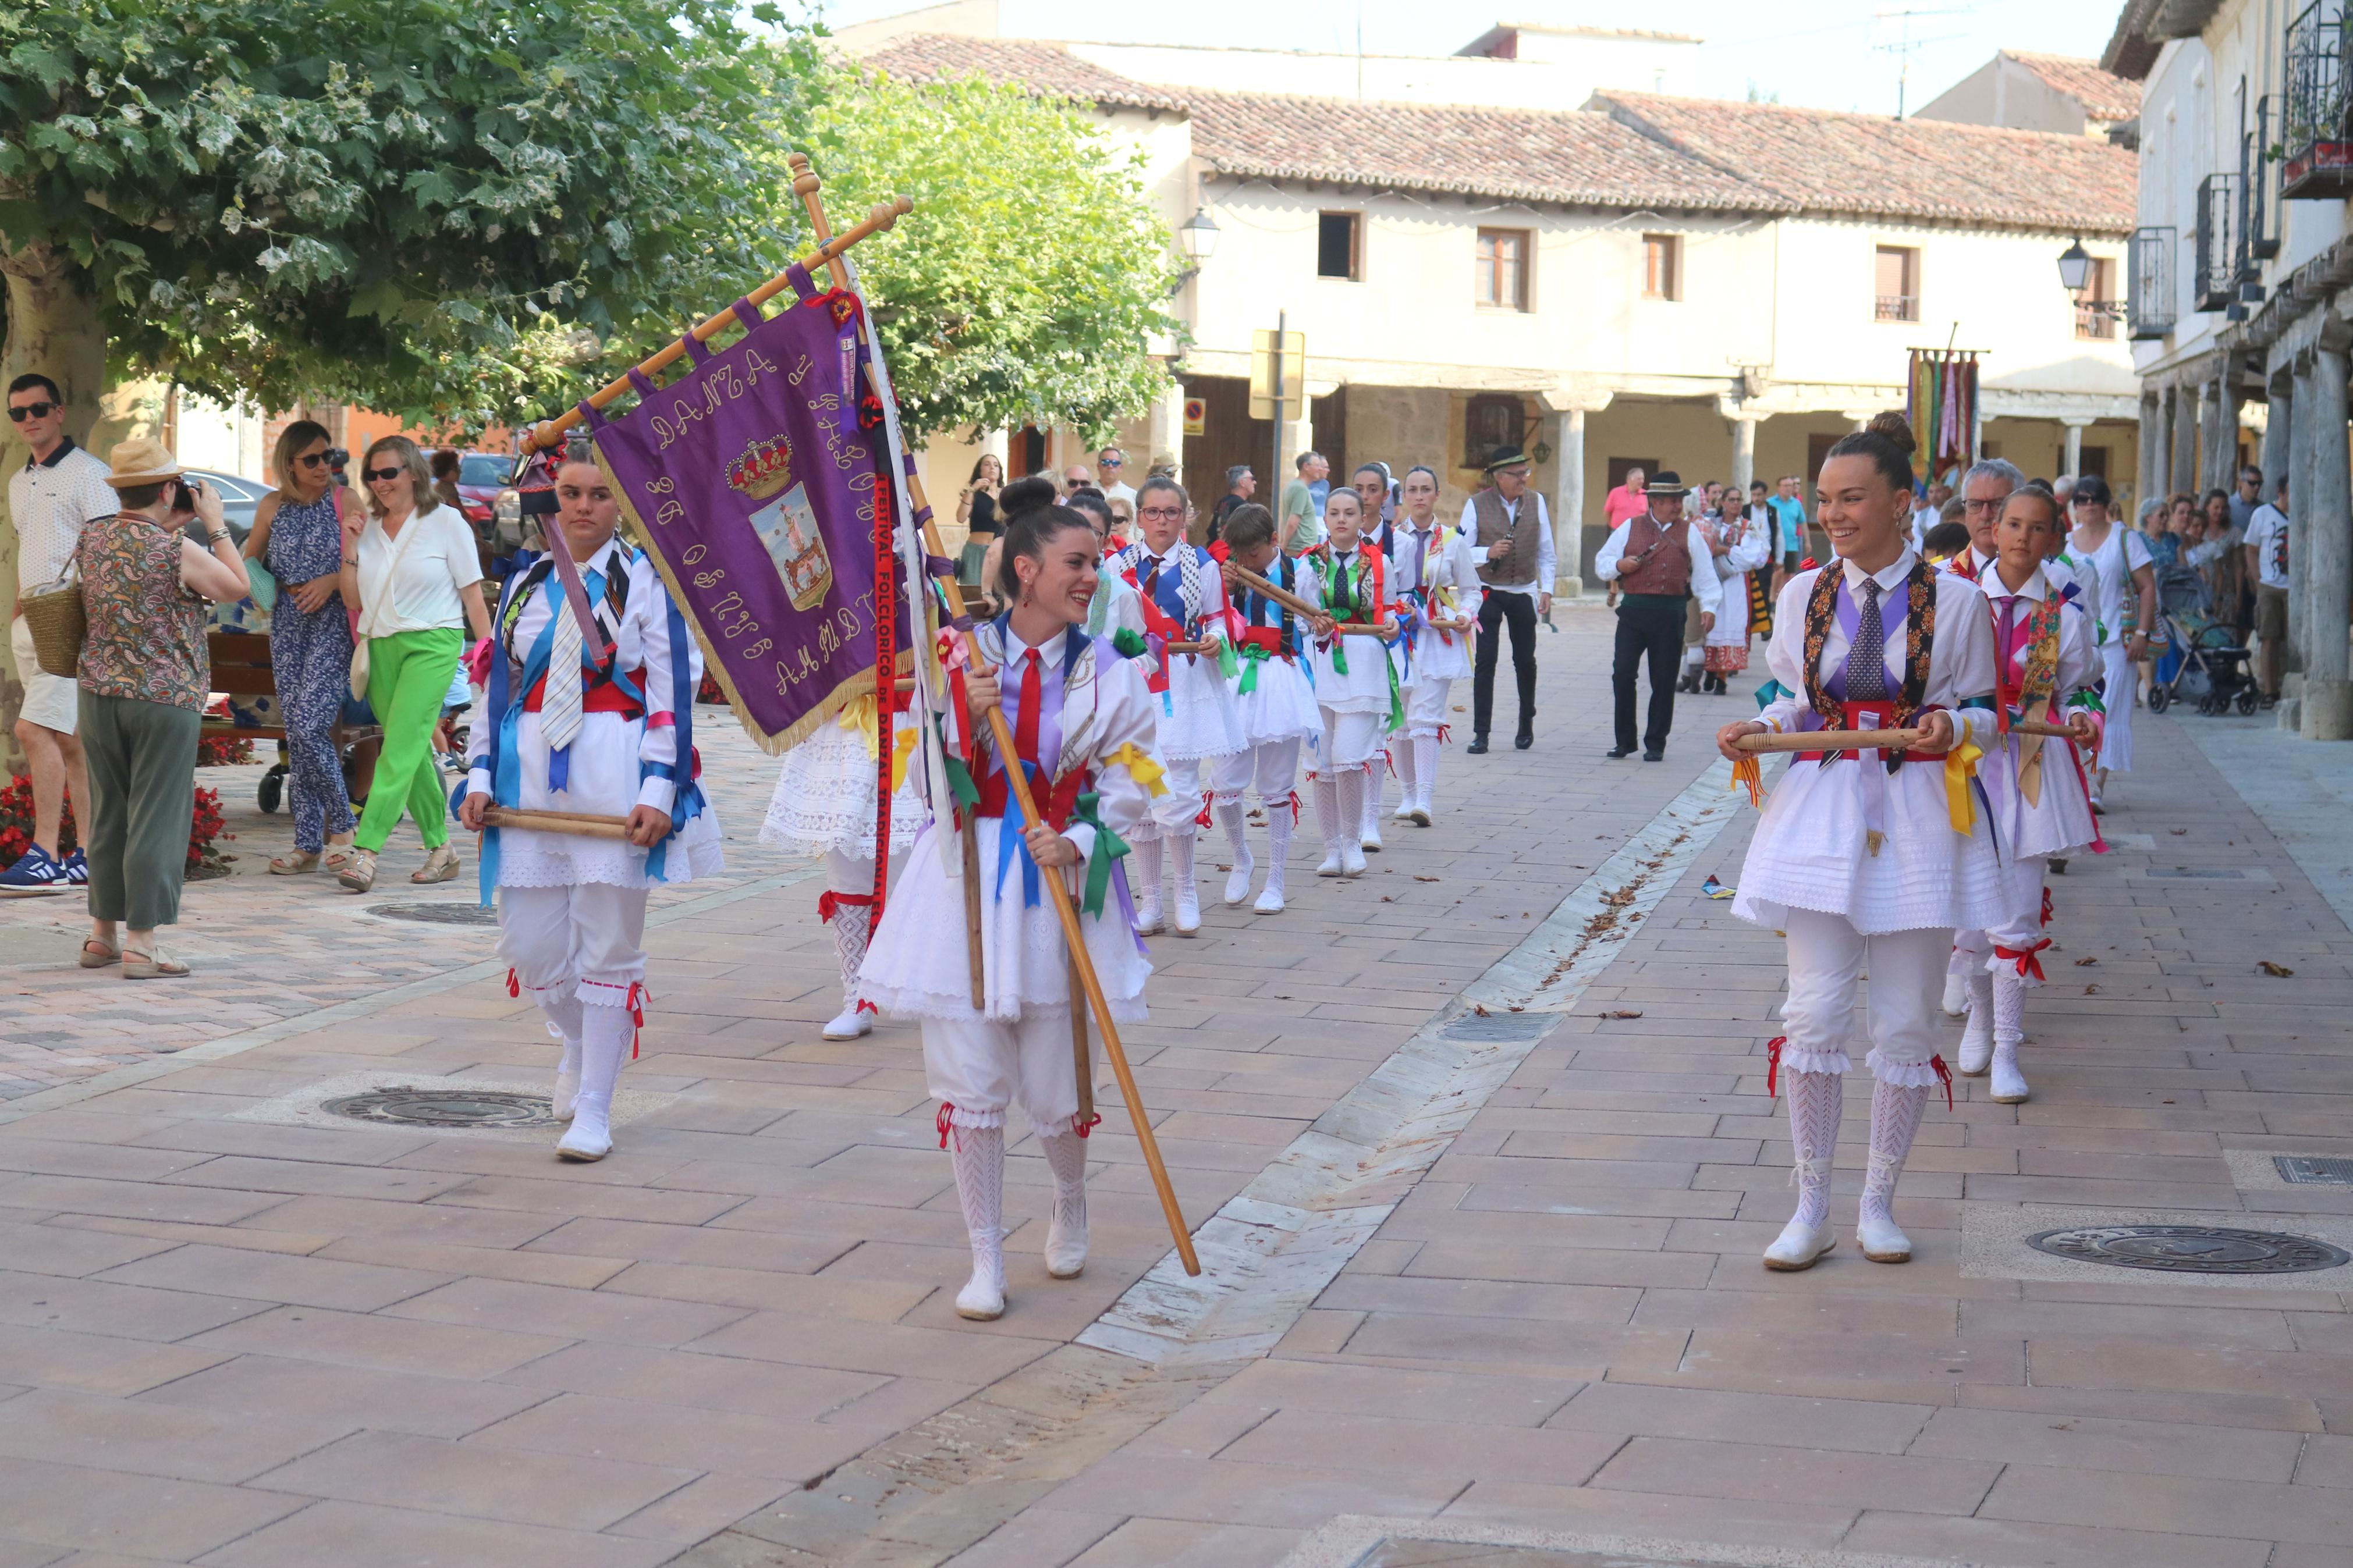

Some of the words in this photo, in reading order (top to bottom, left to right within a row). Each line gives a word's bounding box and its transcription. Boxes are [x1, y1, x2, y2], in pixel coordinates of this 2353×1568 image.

[651, 349, 778, 450] DANZA
[645, 477, 684, 525] DE
[878, 488, 889, 561] FESTIVAL
[683, 544, 772, 659] GRUPO
[776, 586, 910, 695] AMPUDI
[879, 572, 890, 677] FOLCLORICO
[879, 687, 888, 703] DE
[879, 713, 888, 779] DANZAS
[871, 789, 888, 918] TRADICIONALES
